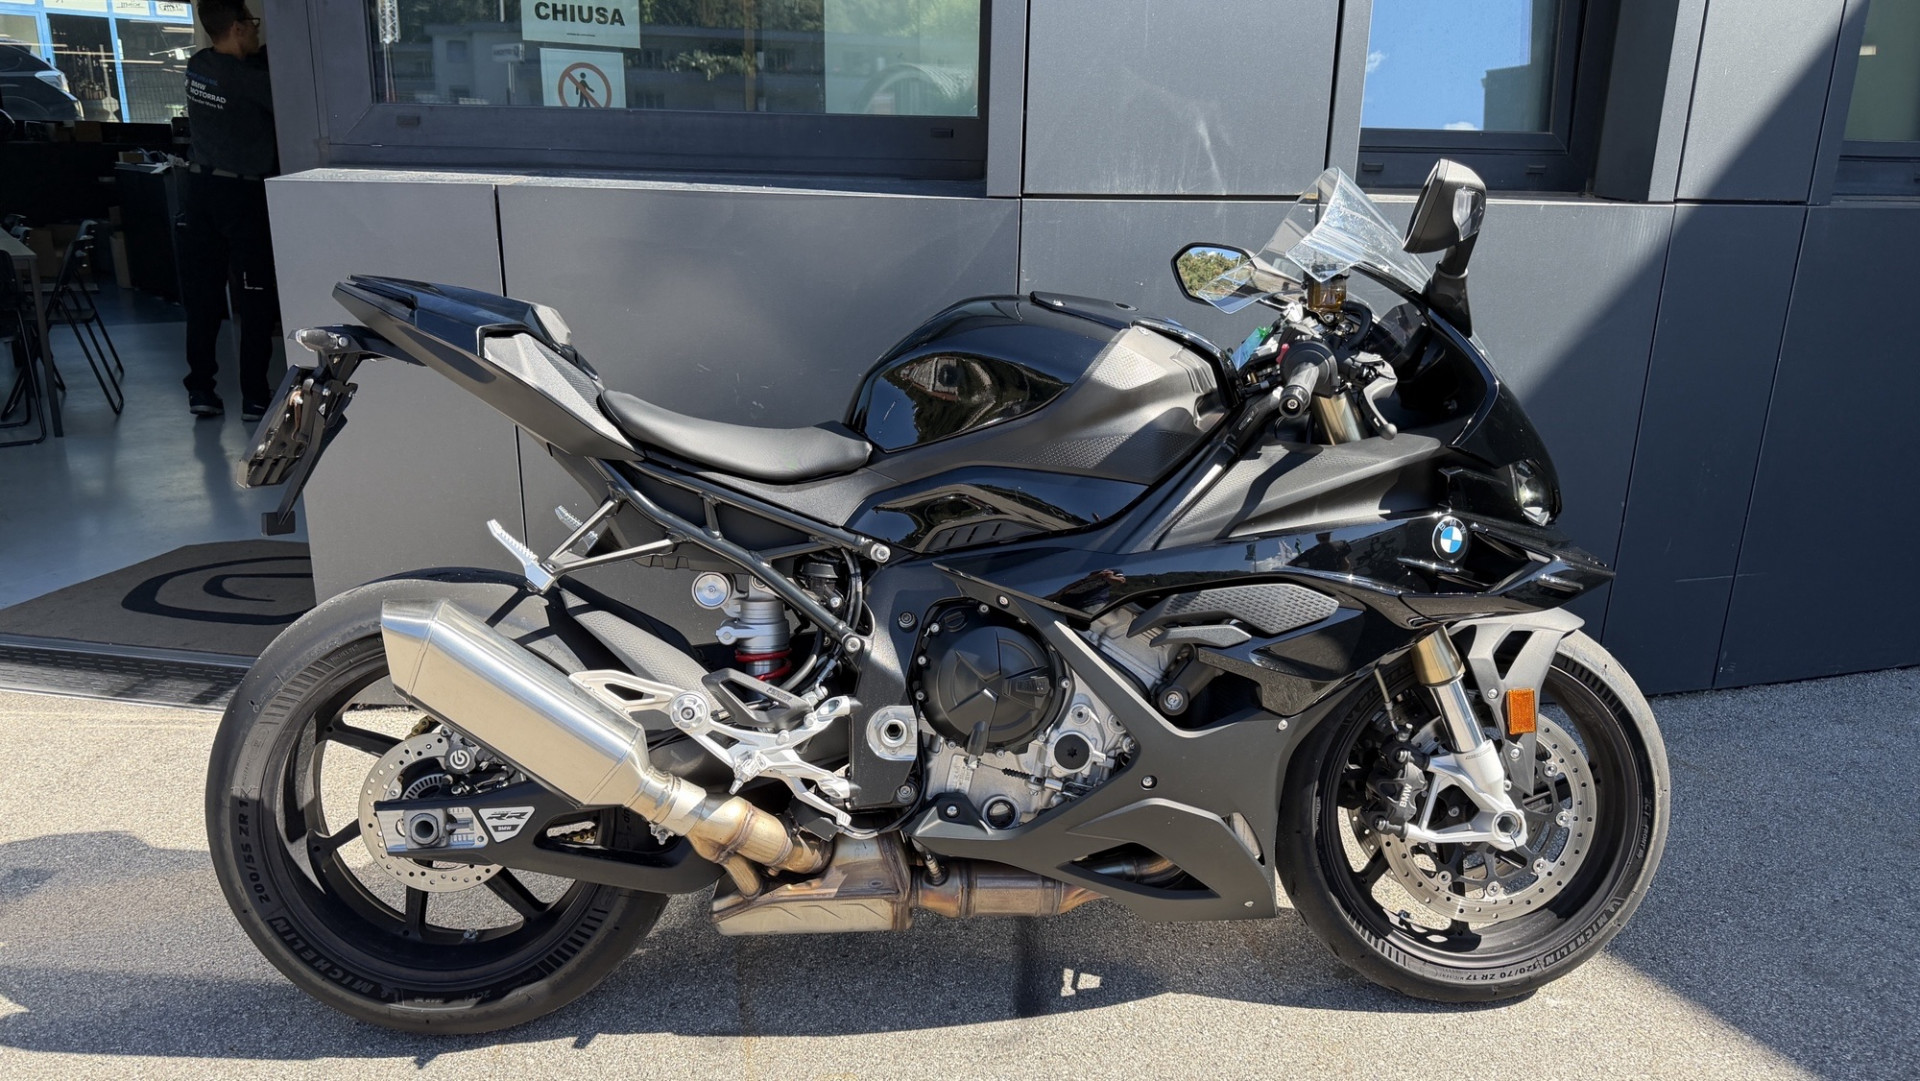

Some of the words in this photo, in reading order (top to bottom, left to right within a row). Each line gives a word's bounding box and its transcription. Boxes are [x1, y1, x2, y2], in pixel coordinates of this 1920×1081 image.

[534, 1, 626, 27] CHIUSA
[190, 86, 226, 104] MOTORRAD
[191, 80, 206, 90] BMW
[1399, 783, 1412, 808] BMW
[238, 812, 249, 837] ZR
[240, 842, 271, 903] 200/55
[1544, 913, 1609, 967] MICHELIN
[270, 915, 376, 995] MICHELIN
[1481, 973, 1496, 981] ZR
[1500, 962, 1539, 978] 120/70
